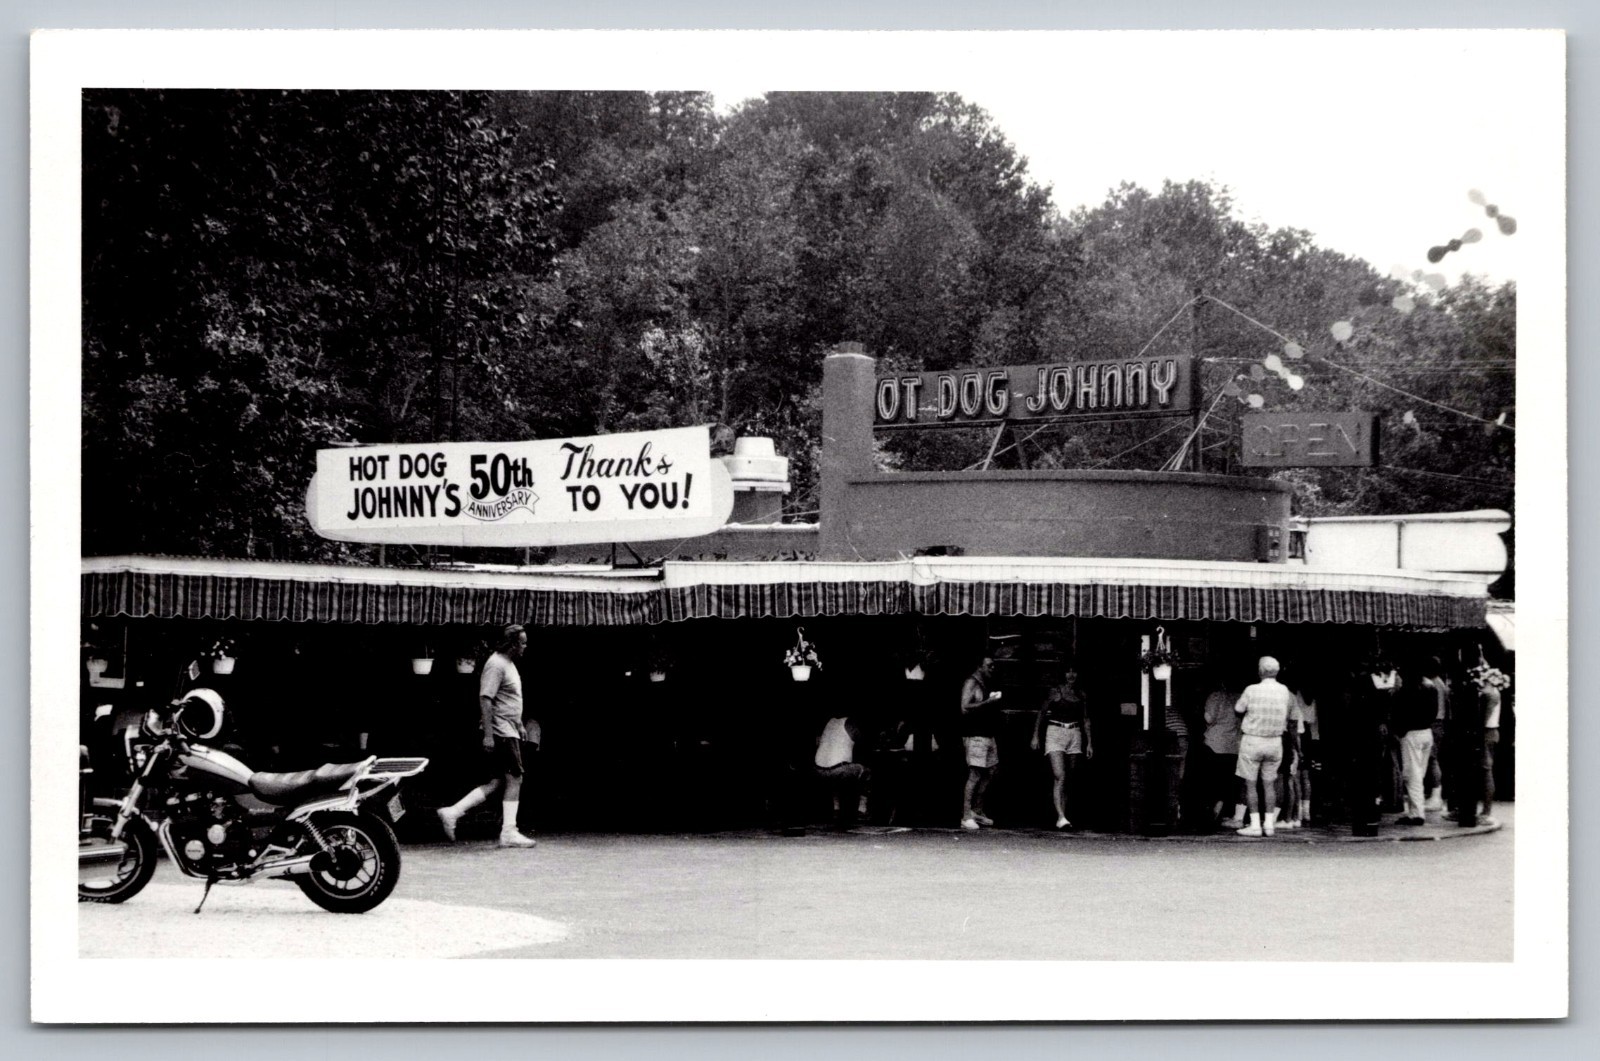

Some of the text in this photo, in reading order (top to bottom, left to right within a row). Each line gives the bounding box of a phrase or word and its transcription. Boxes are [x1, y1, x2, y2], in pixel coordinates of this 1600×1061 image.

[877, 359, 1175, 421] OT DOG JOHNNY
[1251, 422, 1361, 456] OPEN
[349, 453, 446, 481] HOT DOG
[470, 453, 533, 500] 50th
[560, 442, 672, 481] Thanks
[346, 480, 461, 520] JOHNNY'S
[468, 491, 532, 518] ANNIVERSARY
[567, 473, 693, 511] TO YOU!
